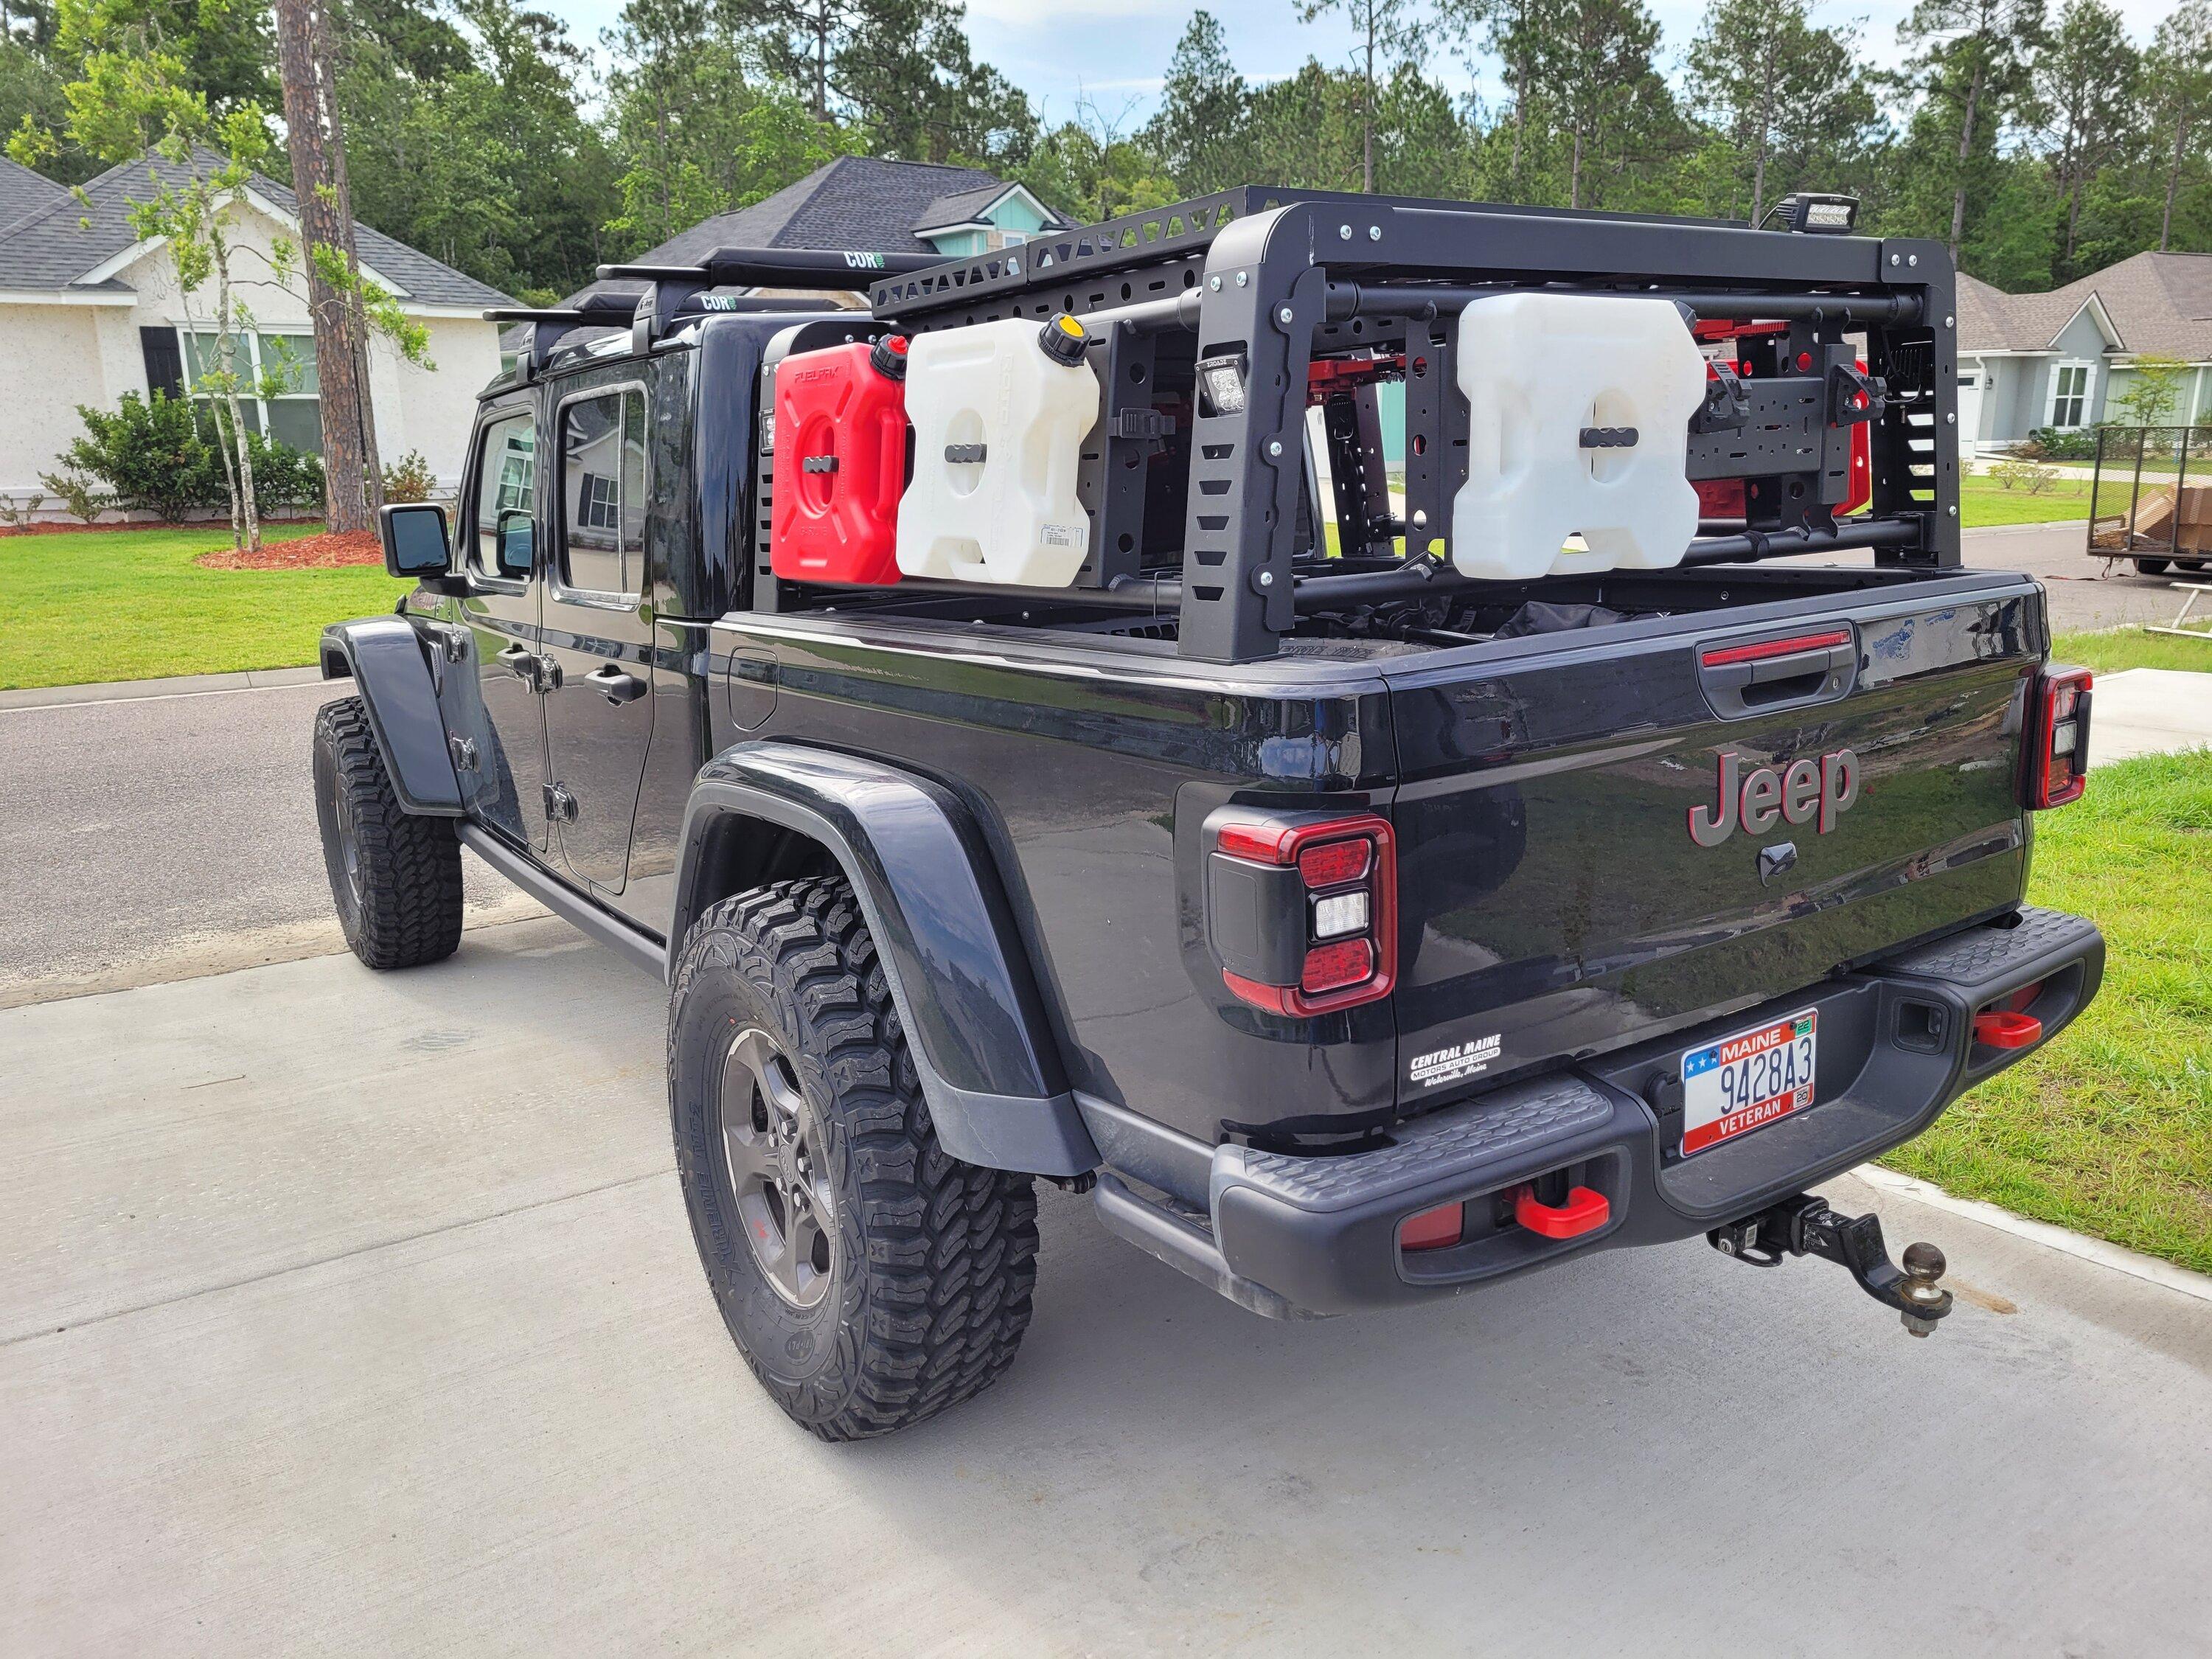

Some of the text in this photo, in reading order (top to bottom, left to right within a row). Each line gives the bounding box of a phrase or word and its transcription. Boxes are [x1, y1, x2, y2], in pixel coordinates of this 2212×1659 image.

[844, 251, 877, 268] COR
[700, 295, 730, 310] COR
[1688, 748, 1860, 847] Jeep
[1411, 1034, 1502, 1070] CENTRAL MAINE
[1722, 1029, 1781, 1062] MAINE
[1413, 1048, 1498, 1079] MOTORS AUTO GROUP
[1464, 1063, 1487, 1076] Maine
[1720, 1037, 1812, 1115] 9428A3
[1719, 1099, 1781, 1135] VETERAN
